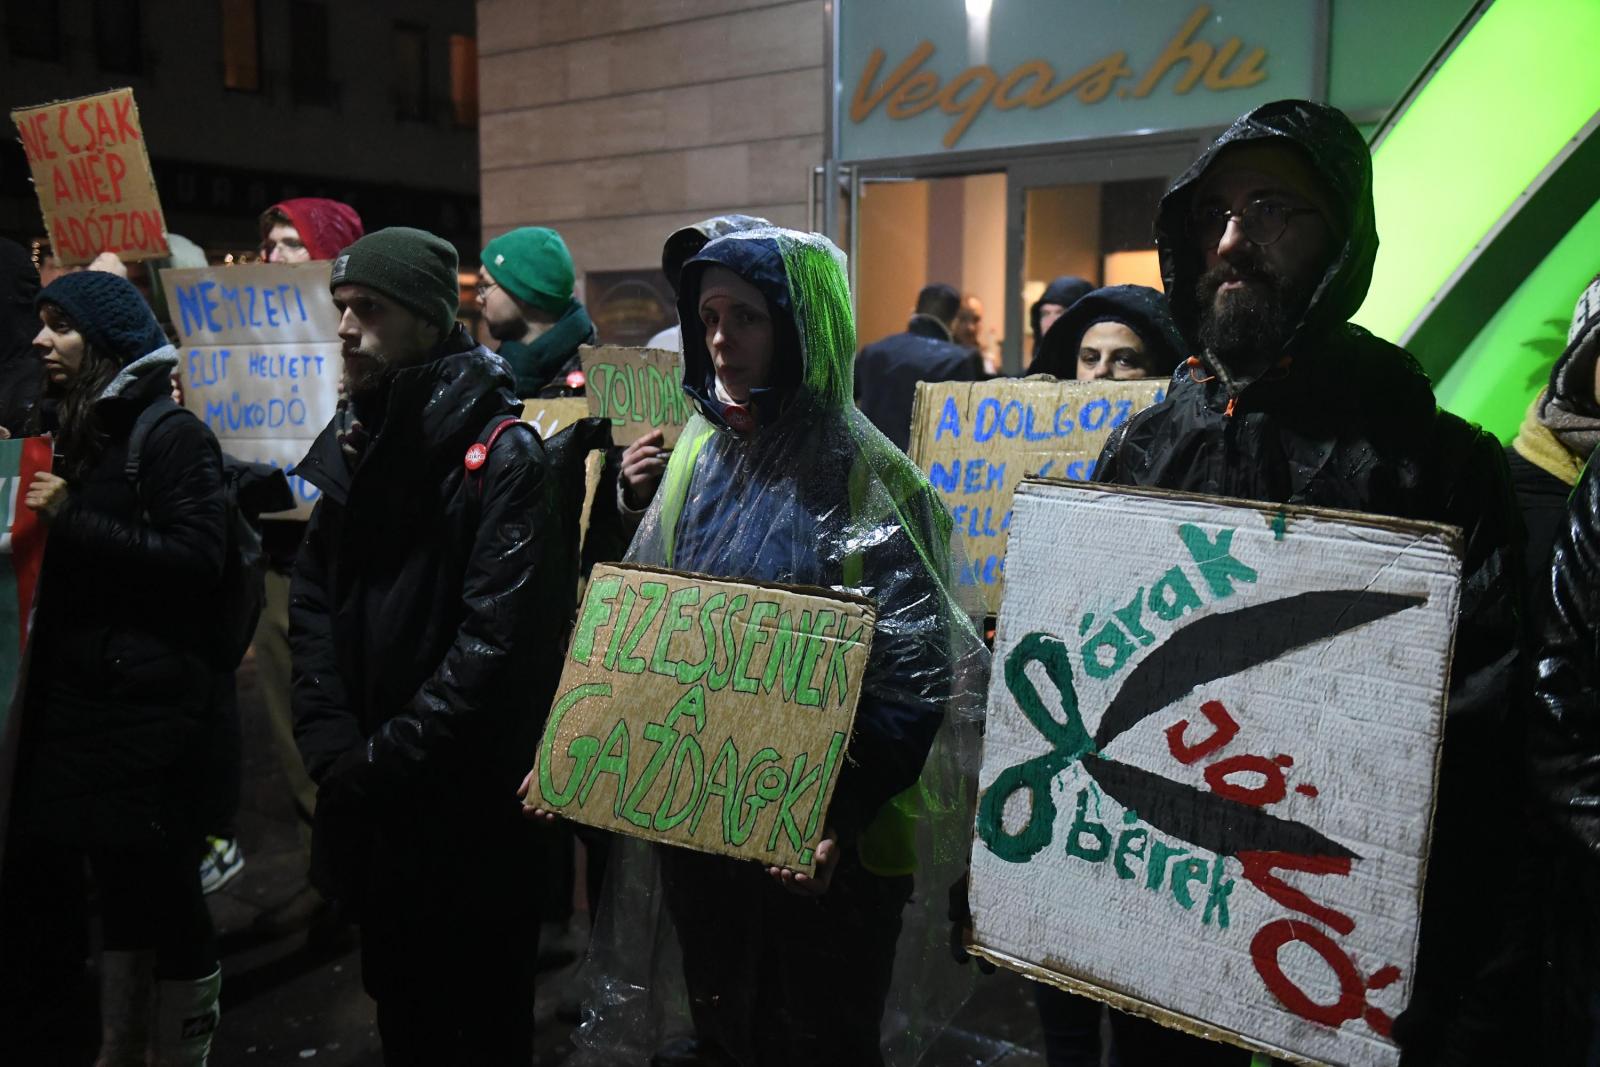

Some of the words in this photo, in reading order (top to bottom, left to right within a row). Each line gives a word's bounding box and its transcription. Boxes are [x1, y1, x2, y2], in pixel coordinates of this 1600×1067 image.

[848, 6, 1267, 149] Vegas.hu
[18, 112, 58, 166] NE
[57, 95, 140, 154] CSAK
[53, 207, 170, 259] ADÓZZON
[176, 281, 308, 337] NEMZETI
[248, 352, 325, 379] HELYETT
[935, 396, 961, 442] A
[973, 387, 1164, 443] DOLGOZ
[930, 458, 1006, 494] NEM
[570, 573, 865, 712] FIZESSENEK
[664, 684, 707, 735] A
[537, 682, 846, 866] GAZDAGOK!
